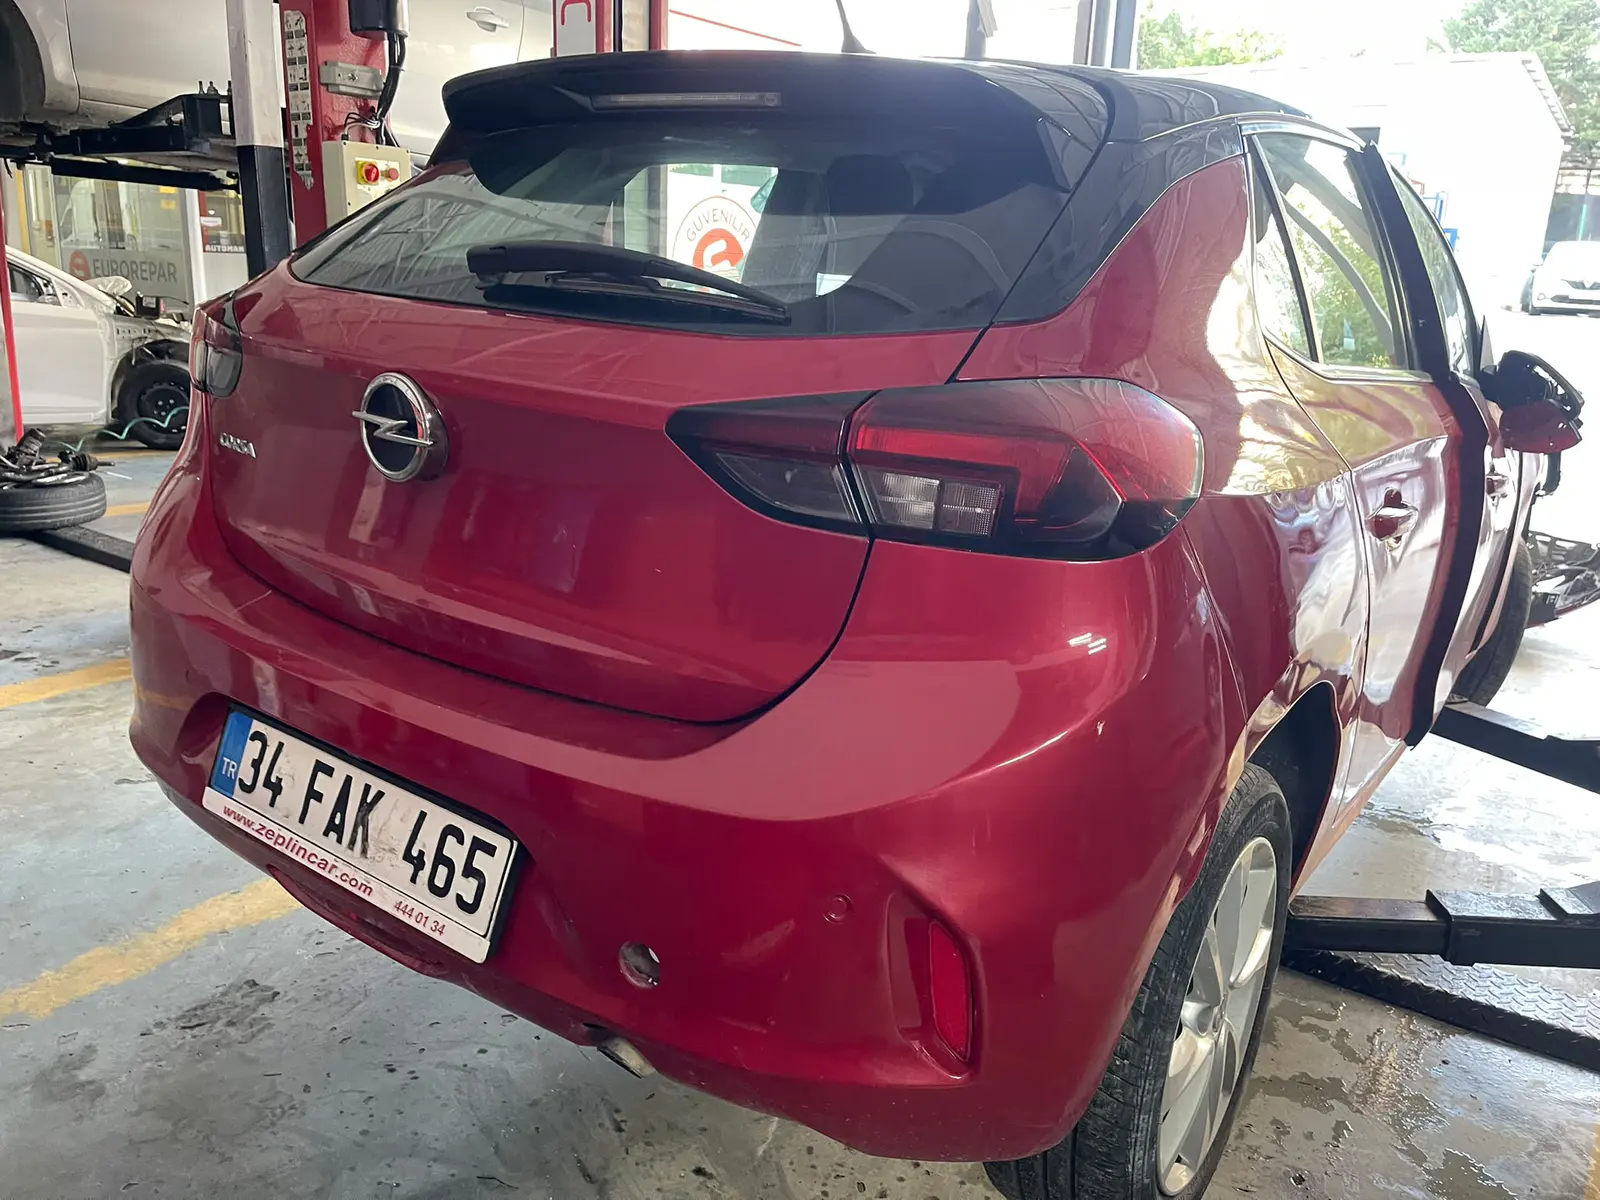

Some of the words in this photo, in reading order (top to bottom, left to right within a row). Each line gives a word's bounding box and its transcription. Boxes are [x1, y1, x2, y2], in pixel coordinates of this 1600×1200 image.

[92, 258, 177, 284] EUROREPAR
[222, 757, 238, 780] TR
[238, 731, 285, 808] 34
[298, 759, 386, 860] FAK
[402, 810, 498, 915] 465
[223, 804, 374, 897] www.zeplincar.com
[393, 900, 414, 920] 444
[415, 910, 430, 928] 01
[432, 919, 446, 937] 34
